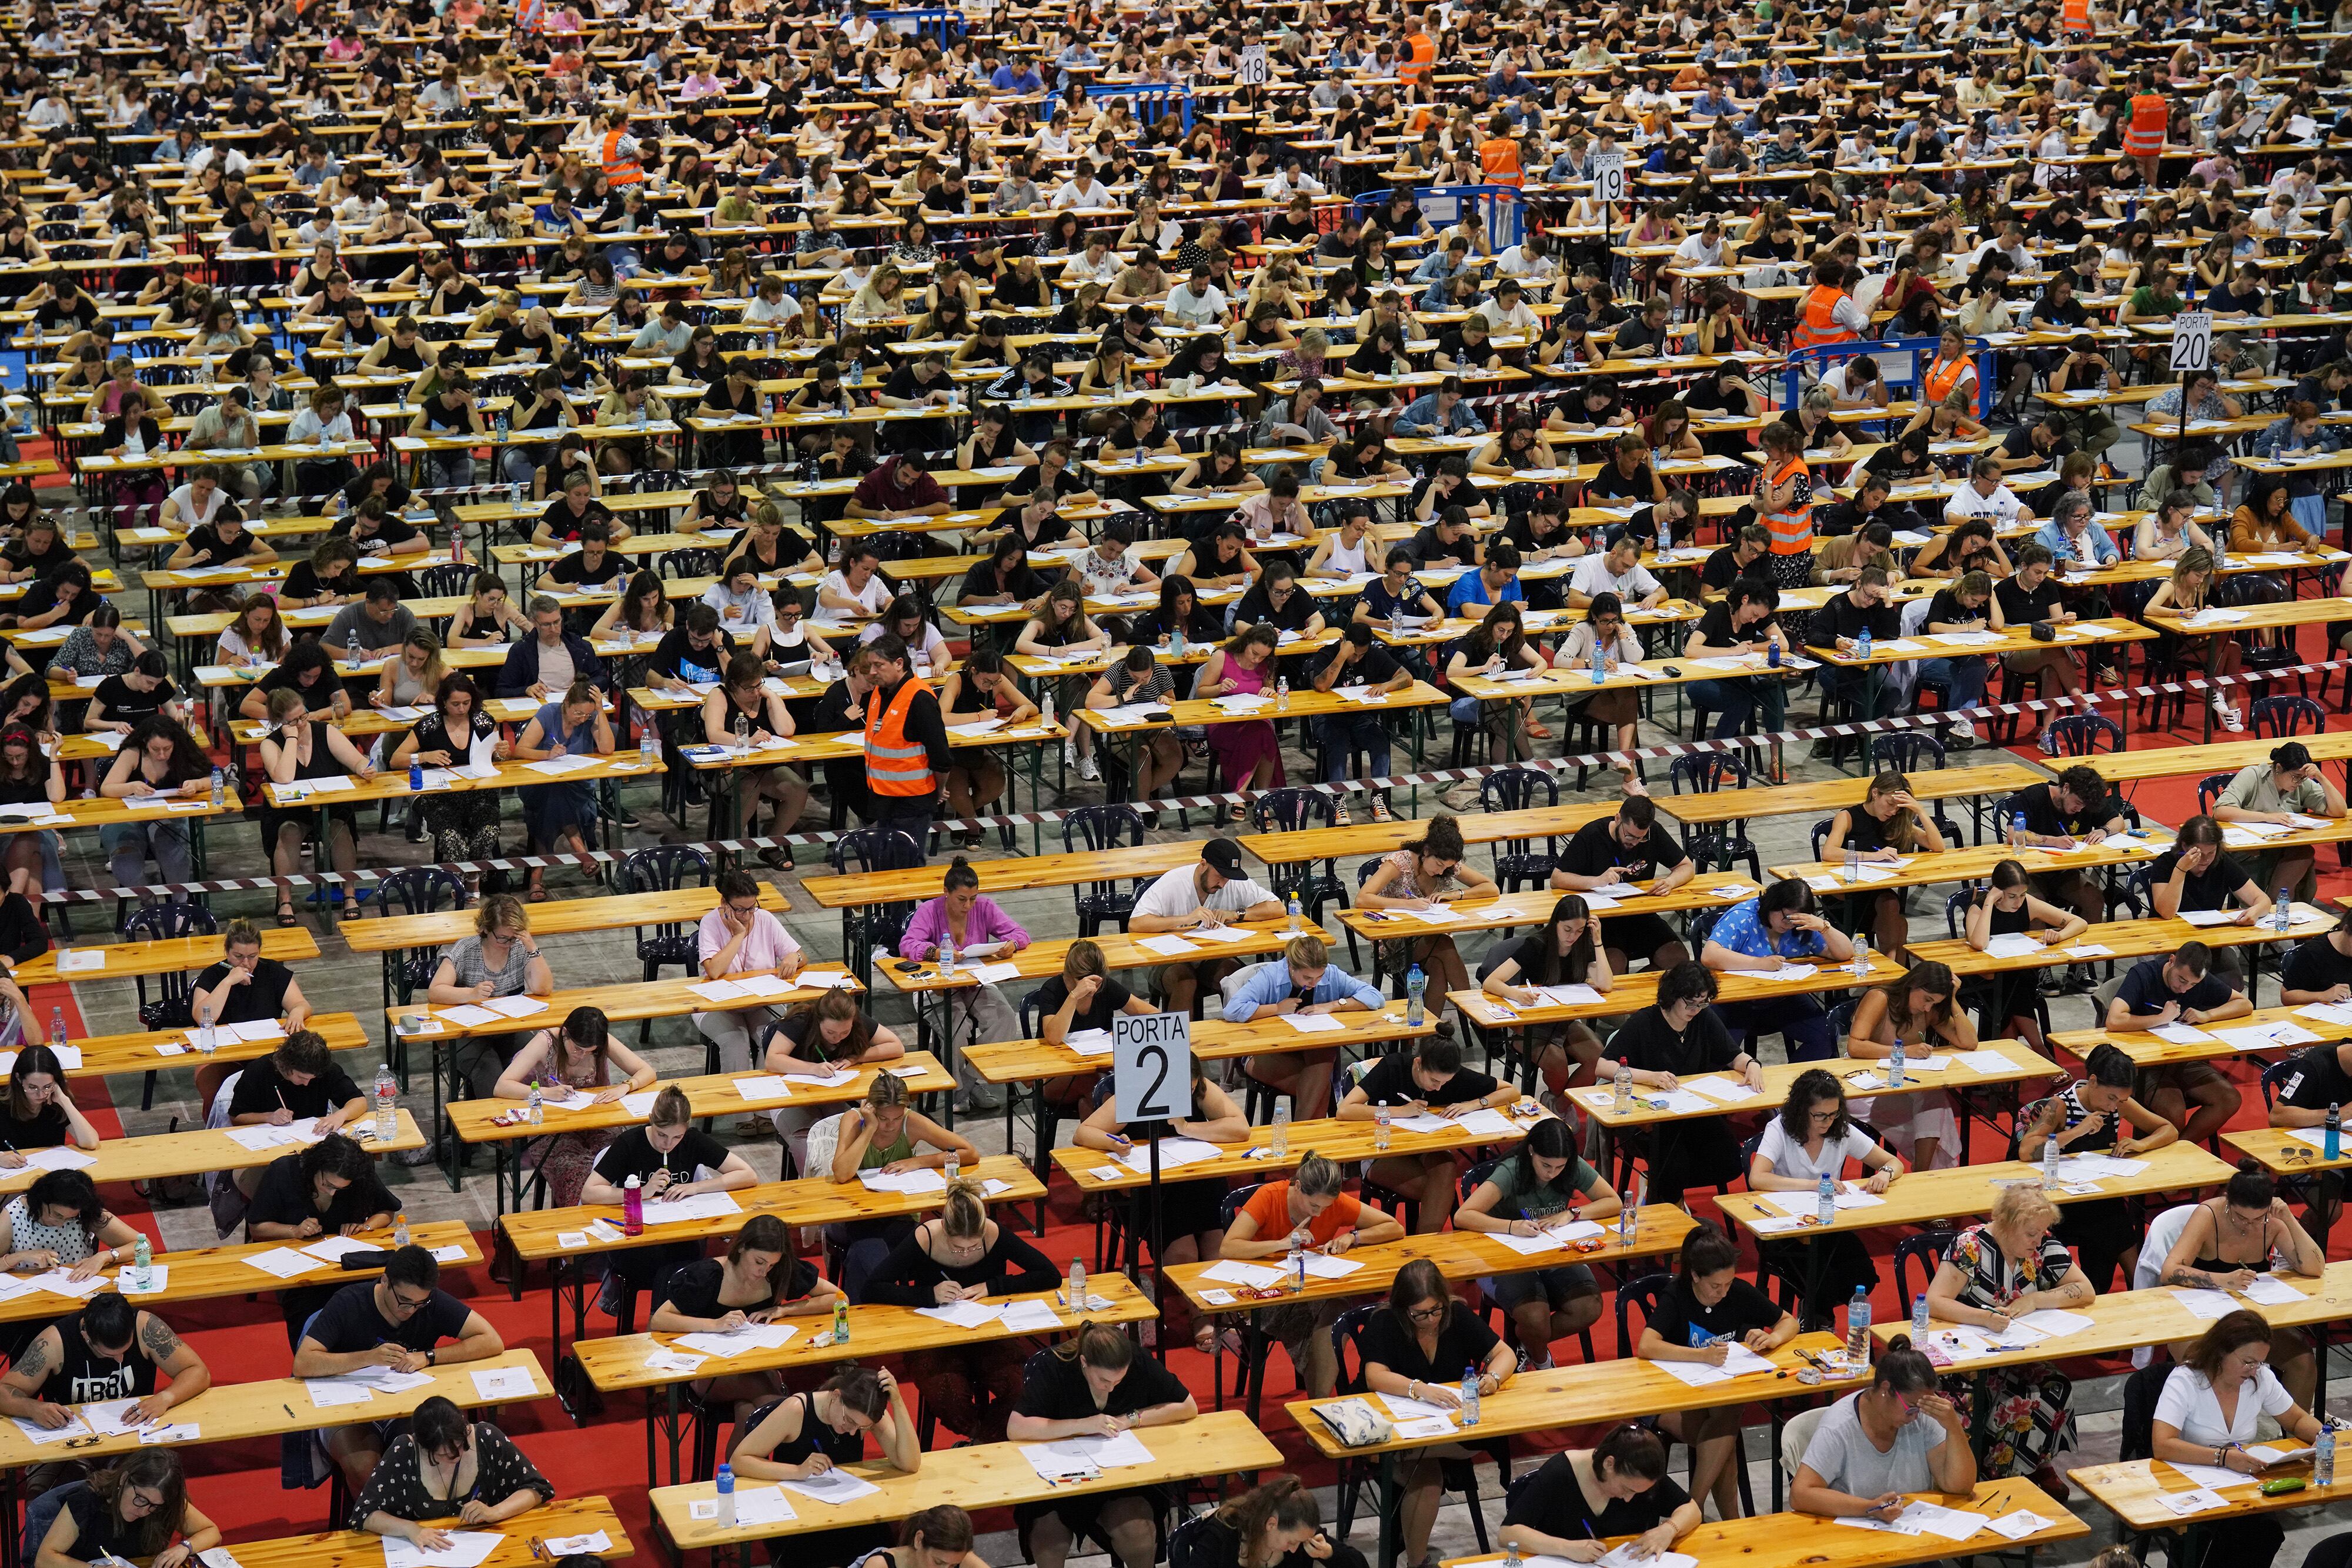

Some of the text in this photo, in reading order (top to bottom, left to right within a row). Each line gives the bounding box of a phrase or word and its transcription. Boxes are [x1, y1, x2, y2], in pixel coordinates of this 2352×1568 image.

[1244, 46, 1264, 56] PORTA
[1244, 58, 1263, 82] 18
[1595, 155, 1621, 166] PORTA
[1595, 169, 1621, 199] 19
[2179, 316, 2209, 329] PORTA
[2173, 333, 2205, 369] 20
[1117, 1015, 1185, 1045] PORTA
[1136, 1045, 1170, 1117] 2
